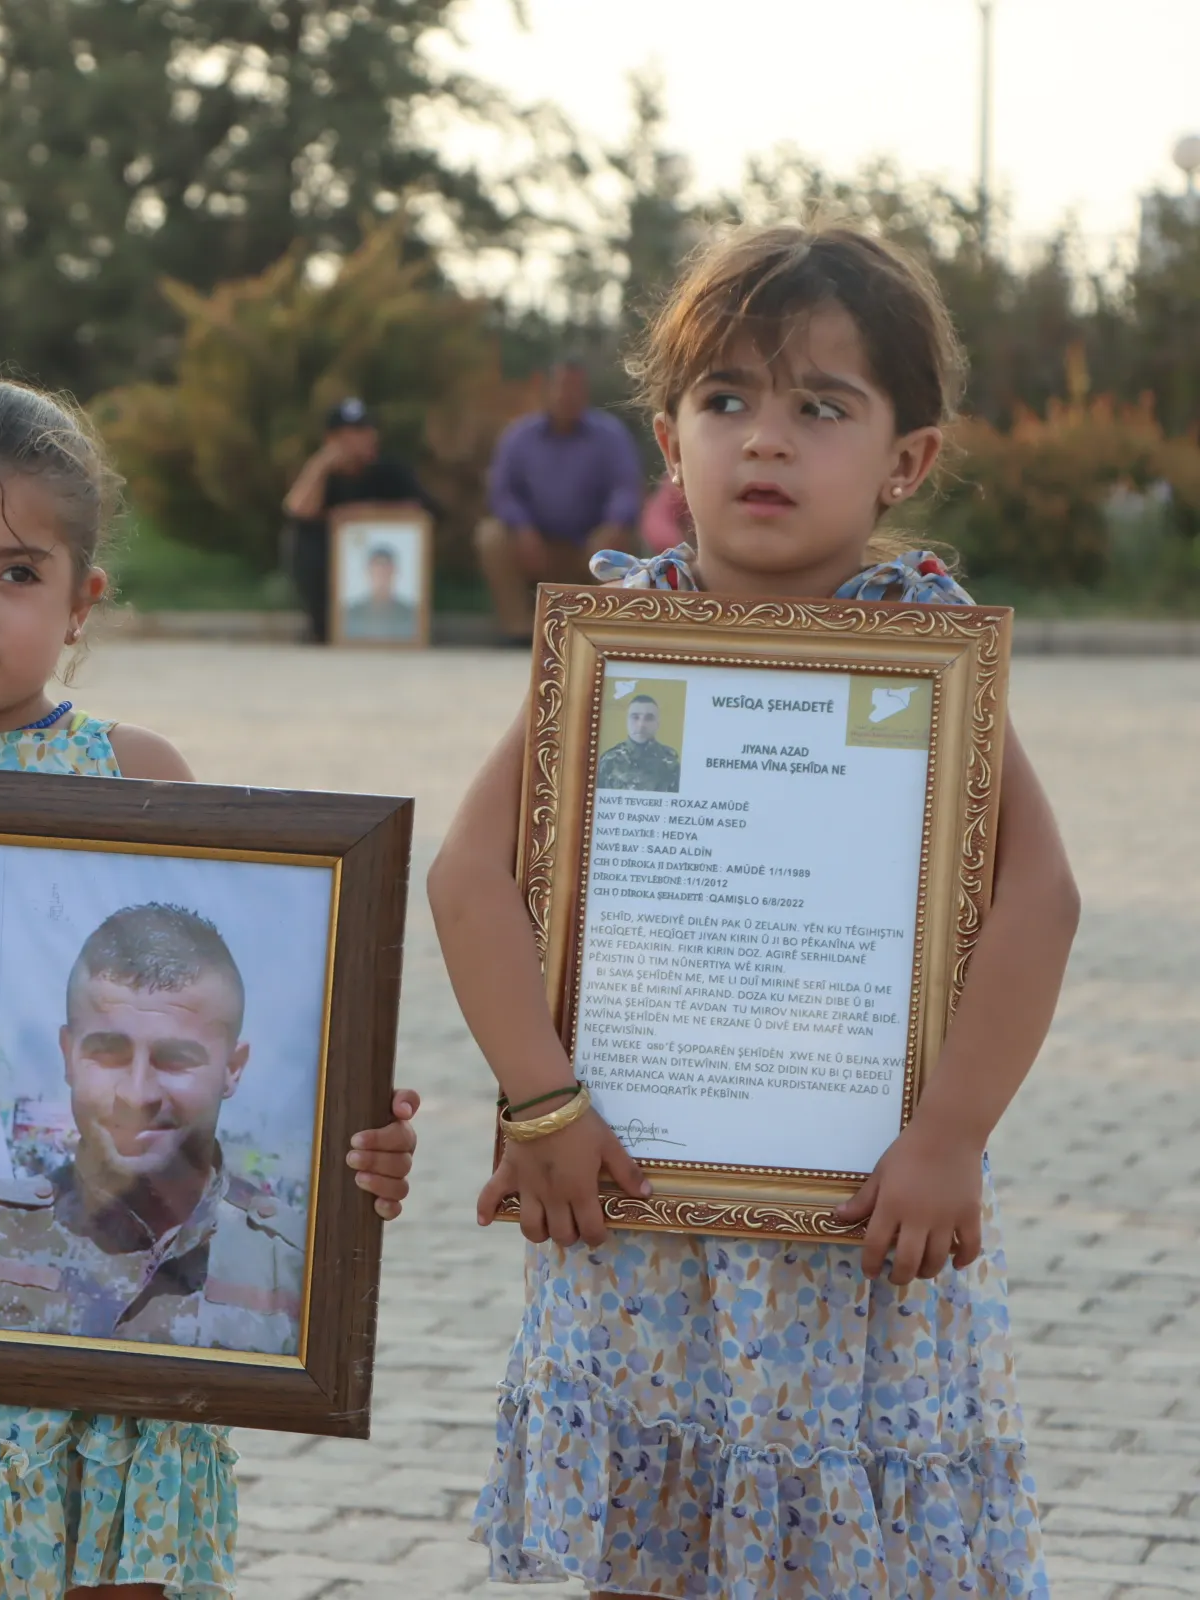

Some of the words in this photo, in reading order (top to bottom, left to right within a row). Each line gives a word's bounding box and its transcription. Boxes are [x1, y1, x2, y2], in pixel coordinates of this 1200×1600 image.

[712, 695, 764, 710] WESÎQA
[768, 699, 834, 713] ŞEHADETÊ
[742, 744, 777, 756] JIYANA
[780, 746, 809, 757] AZAD
[706, 758, 758, 770] BERHEMA
[761, 758, 787, 772] VÎNA
[790, 760, 829, 774] ŞEHÎDA
[832, 764, 846, 775] NE
[671, 799, 708, 809] ROXAZ
[710, 800, 749, 811] AMÛDÊ
[669, 816, 714, 826] MEZLÛM
[717, 818, 746, 828] ASED
[662, 830, 698, 840] HEDYA
[647, 845, 677, 855] SAAD
[679, 846, 712, 856] ALDÎN
[726, 864, 766, 875] AMÛDÊ
[770, 867, 811, 877] 1/1/1989
[762, 897, 804, 908] 6/8/2022
[601, 911, 634, 924] ŞEHÎD,
[637, 914, 684, 925] XWEDIYÊ
[688, 916, 718, 927] DILÊN
[721, 919, 741, 929] PAK
[744, 918, 752, 929] Û
[803, 922, 824, 934] YÊN
[827, 925, 842, 934] KU
[845, 924, 904, 939] TÊGIHIŞTIN
[591, 924, 646, 939] HEQÎQETÊ,
[650, 927, 696, 940] HEQÎQET
[699, 931, 727, 942] JIYAN
[730, 934, 758, 944] KIRIN
[762, 933, 769, 944] Û
[772, 936, 779, 945] JI
[782, 937, 798, 946] BO
[801, 936, 855, 950] PÊKANÎNA
[859, 940, 876, 951] WÊ
[589, 950, 634, 963] PÊXISTIN
[638, 953, 646, 964] Û
[648, 956, 669, 966] TIM
[672, 956, 731, 970] NÛNERTIYA
[734, 960, 752, 971] WÊ
[755, 963, 786, 974] KIRIN.
[590, 939, 613, 949] XWE
[678, 944, 704, 954] FIKIR
[706, 946, 734, 956] KIRIN
[738, 948, 762, 958] DOZ.
[766, 949, 797, 960] AGIRÊ
[801, 952, 866, 964] SERHILDANÊ
[597, 967, 606, 976] BI
[610, 968, 634, 978] SAYA
[637, 969, 682, 981] ŞEHÎDÊN
[685, 973, 704, 985] ME,
[709, 974, 724, 984] ME
[729, 976, 736, 985] LI
[762, 977, 800, 989] MIRINÊ
[829, 982, 861, 992] HILDA
[864, 982, 872, 993] Û
[875, 985, 892, 994] ME
[585, 980, 627, 991] JIYANEK
[631, 981, 643, 992] BÊ
[685, 987, 734, 998] AFIRAND.
[738, 990, 767, 1000] DOZA
[771, 992, 784, 1002] KU
[788, 994, 822, 1004] MEZIN
[826, 996, 849, 1006] DIBE
[854, 995, 861, 1007] Û
[865, 998, 874, 1008] BI
[586, 993, 622, 1006] XWÎNA
[625, 996, 671, 1009] ŞEHÎDAN
[674, 998, 686, 1010] TÊ
[690, 1001, 727, 1012] AVDAN
[732, 1004, 747, 1014] TU
[751, 1006, 787, 1016] MIROV
[790, 1008, 828, 1019] NIKARE
[832, 1010, 869, 1022] ZIRARÊ
[872, 1012, 900, 1024] BIDÊ.
[585, 1008, 621, 1020] XWÎNA
[624, 1010, 669, 1023] ŞEHÎDÊN
[673, 1014, 689, 1024] ME
[693, 1016, 706, 1025] NE
[710, 1017, 751, 1028] ERZANE
[755, 1017, 762, 1029] Û
[766, 1019, 789, 1030] DIVÊ
[793, 1022, 810, 1032] EM
[814, 1023, 843, 1034] MAFÊ
[847, 1026, 874, 1036] WAN
[592, 1038, 608, 1047] EM
[612, 1039, 642, 1050] WEKE
[677, 1044, 735, 1056] ŞOPDARÊN
[738, 1046, 784, 1059] ŞEHÎDÊN
[790, 1051, 814, 1061] XWE
[818, 1052, 832, 1062] NE
[835, 1051, 843, 1062] Û
[846, 1054, 880, 1065] BEJNA
[583, 1052, 590, 1061] LI
[594, 1052, 638, 1064] HEMBER
[642, 1056, 667, 1066] WAN
[735, 1062, 751, 1071] EM
[755, 1063, 774, 1073] SOZ
[778, 1065, 808, 1075] DIDIN
[812, 1067, 825, 1076] KU
[830, 1068, 839, 1077] BI
[843, 1069, 852, 1080] ÇI
[580, 1080, 623, 1091] URIYEK
[627, 1083, 697, 1096] DEMOQRATÎK
[591, 1066, 607, 1078] BE,
[610, 1068, 664, 1080] ARMANCA
[668, 1072, 694, 1082] WAN
[696, 1074, 705, 1083] A
[707, 1074, 764, 1087] AVAKIRINA
[768, 1078, 846, 1092] KURDISTANEKE
[849, 1084, 878, 1094] AZAD
[882, 1084, 890, 1095] Û
